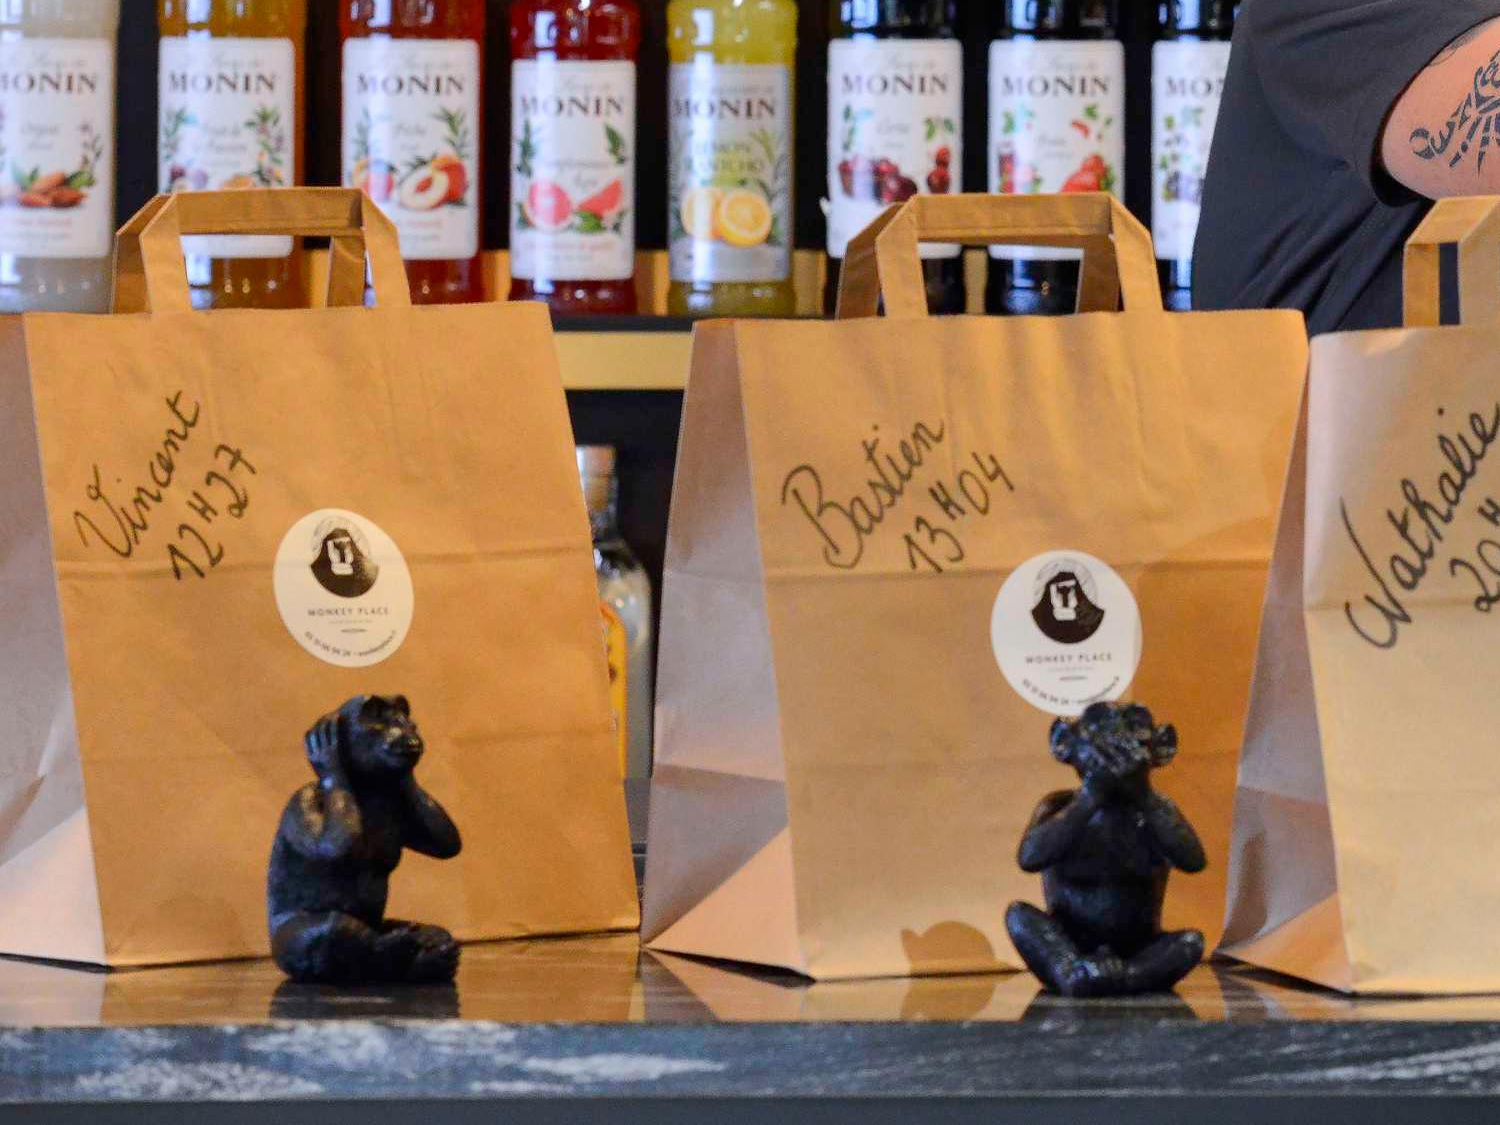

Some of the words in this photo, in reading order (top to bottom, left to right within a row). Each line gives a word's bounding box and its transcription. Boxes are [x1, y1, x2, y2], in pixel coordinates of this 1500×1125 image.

[167, 72, 277, 94] MONIN
[355, 73, 466, 95] MONIN
[841, 74, 950, 96] MONIN
[1001, 75, 1112, 97] MONIN
[519, 94, 625, 118] MONIN
[671, 98, 777, 119] MONIN
[73, 390, 201, 559] Vincent
[780, 418, 945, 569] Bastien
[307, 607, 353, 617] MONKEY
[358, 605, 388, 616] PLACE
[1025, 655, 1074, 665] MONKEY
[1077, 651, 1112, 664] PLACE
